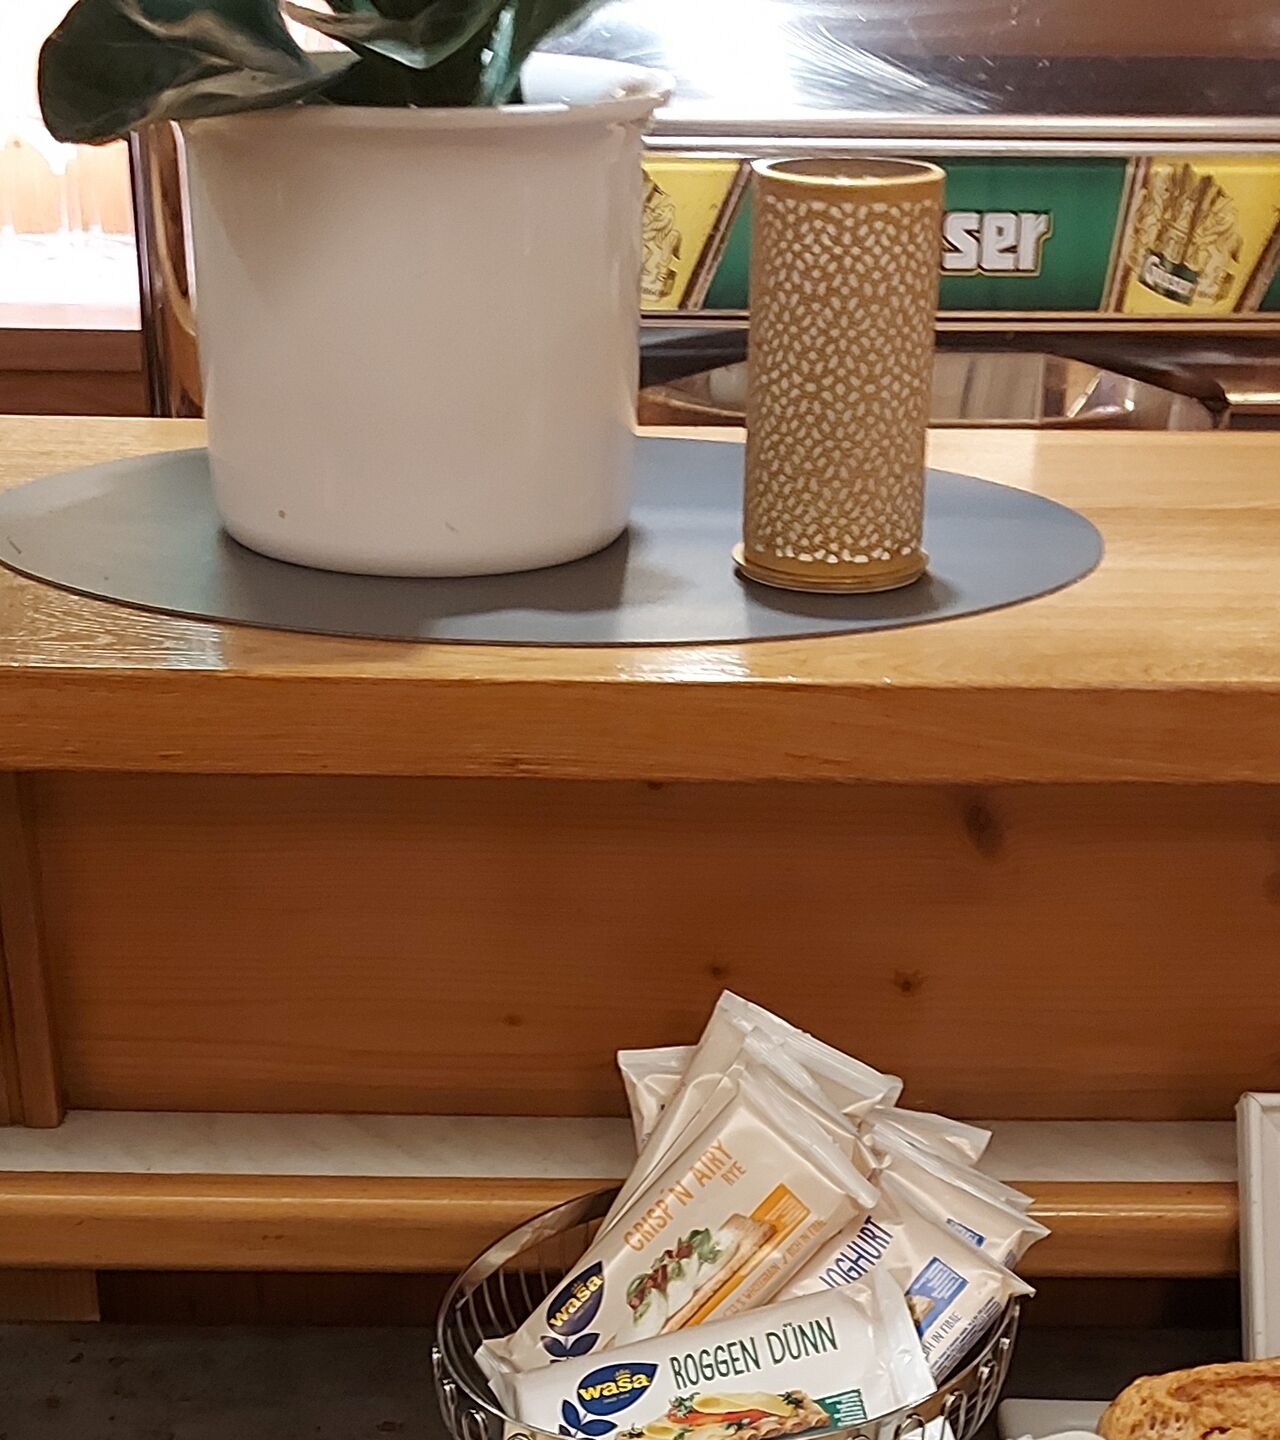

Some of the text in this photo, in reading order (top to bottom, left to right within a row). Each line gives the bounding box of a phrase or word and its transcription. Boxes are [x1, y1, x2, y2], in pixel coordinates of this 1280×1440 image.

[941, 210, 1052, 273] ser
[623, 1198, 674, 1252] CRISP
[688, 1138, 733, 1188] AIRY
[719, 1160, 748, 1187] RYE
[670, 1316, 839, 1391] ROGGEN DÜNN
